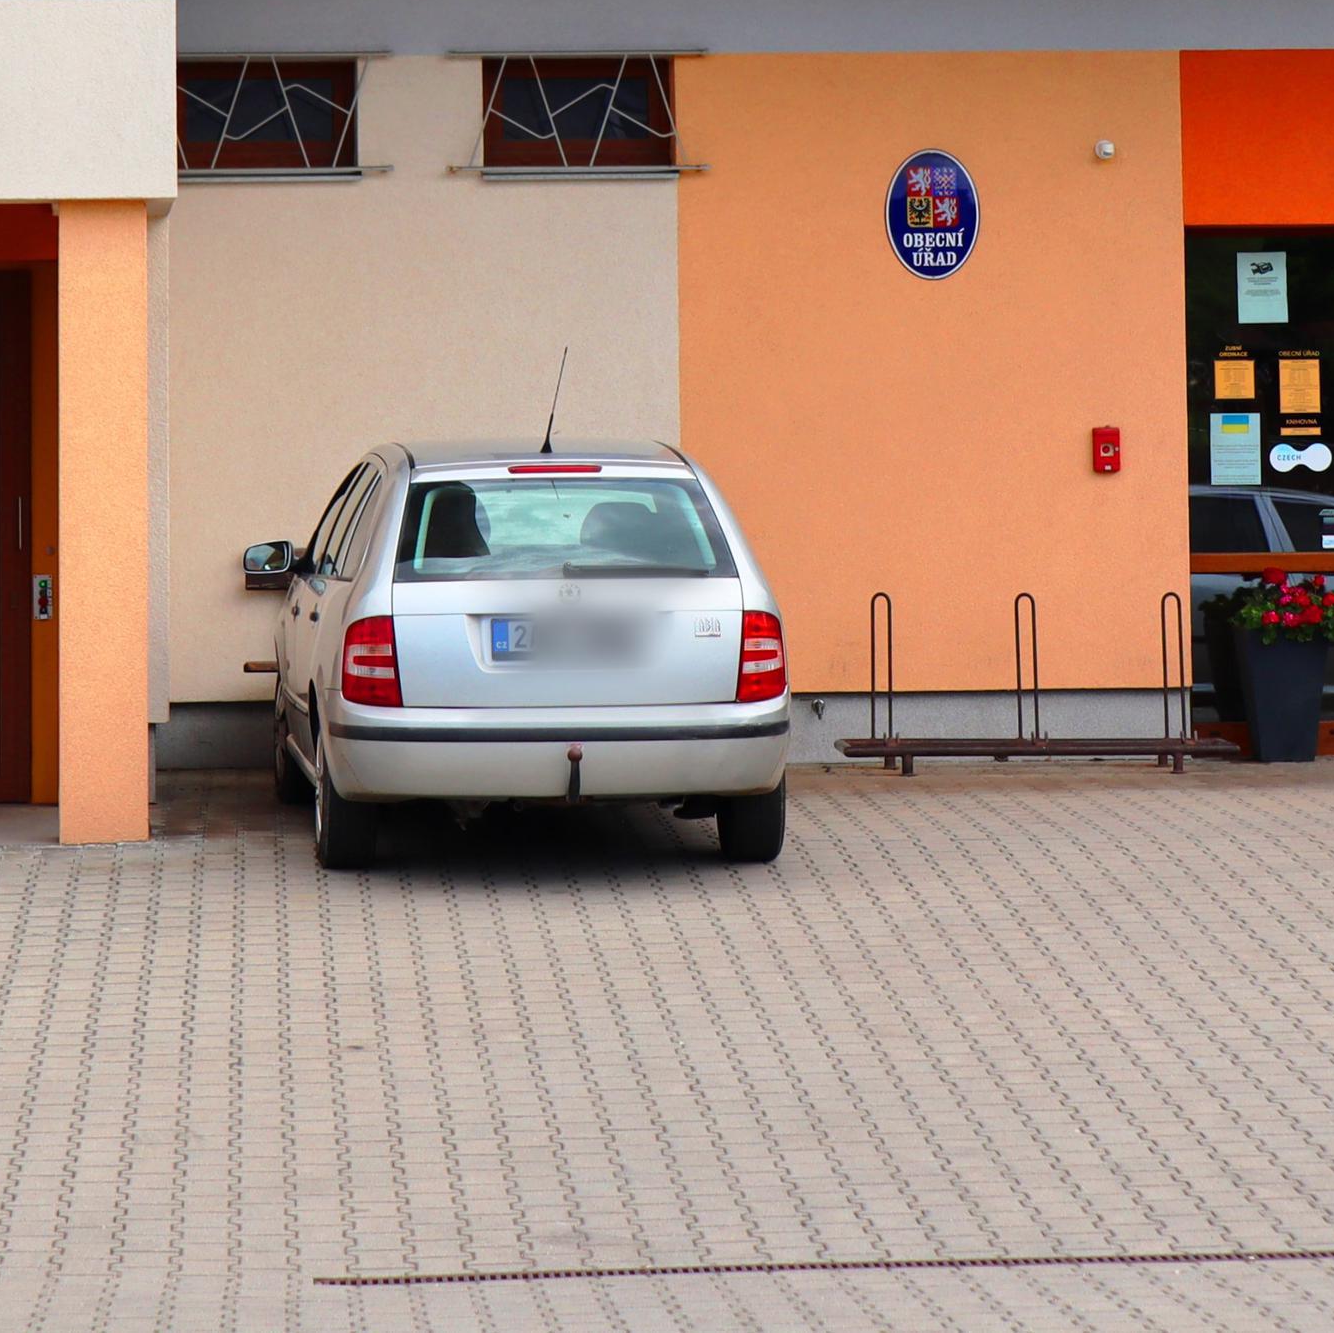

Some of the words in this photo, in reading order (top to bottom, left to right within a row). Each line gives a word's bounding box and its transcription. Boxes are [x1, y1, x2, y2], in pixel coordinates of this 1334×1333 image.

[903, 228, 965, 248] OBECNÍ
[912, 248, 957, 267] ÚŘAD
[496, 641, 508, 649] CZ
